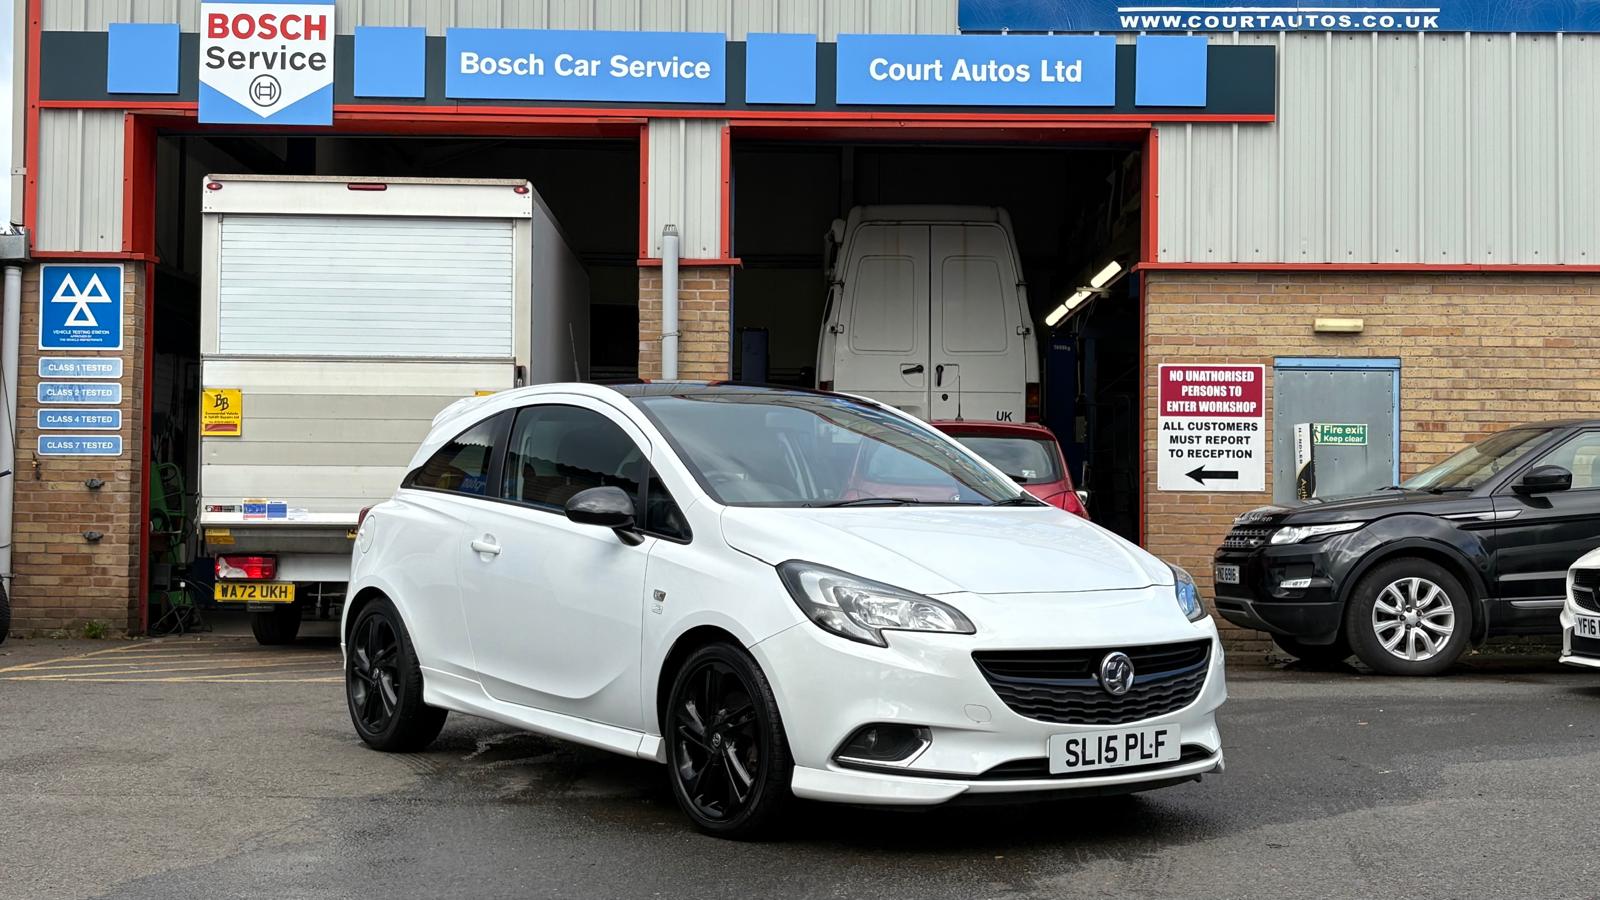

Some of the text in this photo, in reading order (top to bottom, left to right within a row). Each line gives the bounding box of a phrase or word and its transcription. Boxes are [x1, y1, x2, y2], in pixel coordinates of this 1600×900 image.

[207, 13, 326, 40] BOSCH
[1120, 15, 1439, 28] WWW.COURTAUTOS.CO.UK
[205, 45, 326, 71] Service
[460, 52, 711, 79] Bosch Car Service
[869, 58, 1082, 82] Court Autos Ltd
[1169, 370, 1254, 382] NO UNATHORISED
[1181, 385, 1242, 397] PERSONS TO
[1166, 401, 1257, 413] ENTER WORKSHOP
[996, 410, 1012, 422] UK
[1163, 421, 1258, 431] ALL CUSTOMERS
[1323, 425, 1363, 434] Fire exit
[1169, 435, 1251, 445] MUST REPORT
[1323, 435, 1343, 443] Keep
[1168, 449, 1253, 459] TO RECEPTION
[221, 585, 288, 599] WA72 UKH
[1578, 617, 1596, 635] YF16
[1065, 729, 1168, 767] SL15 PLF
